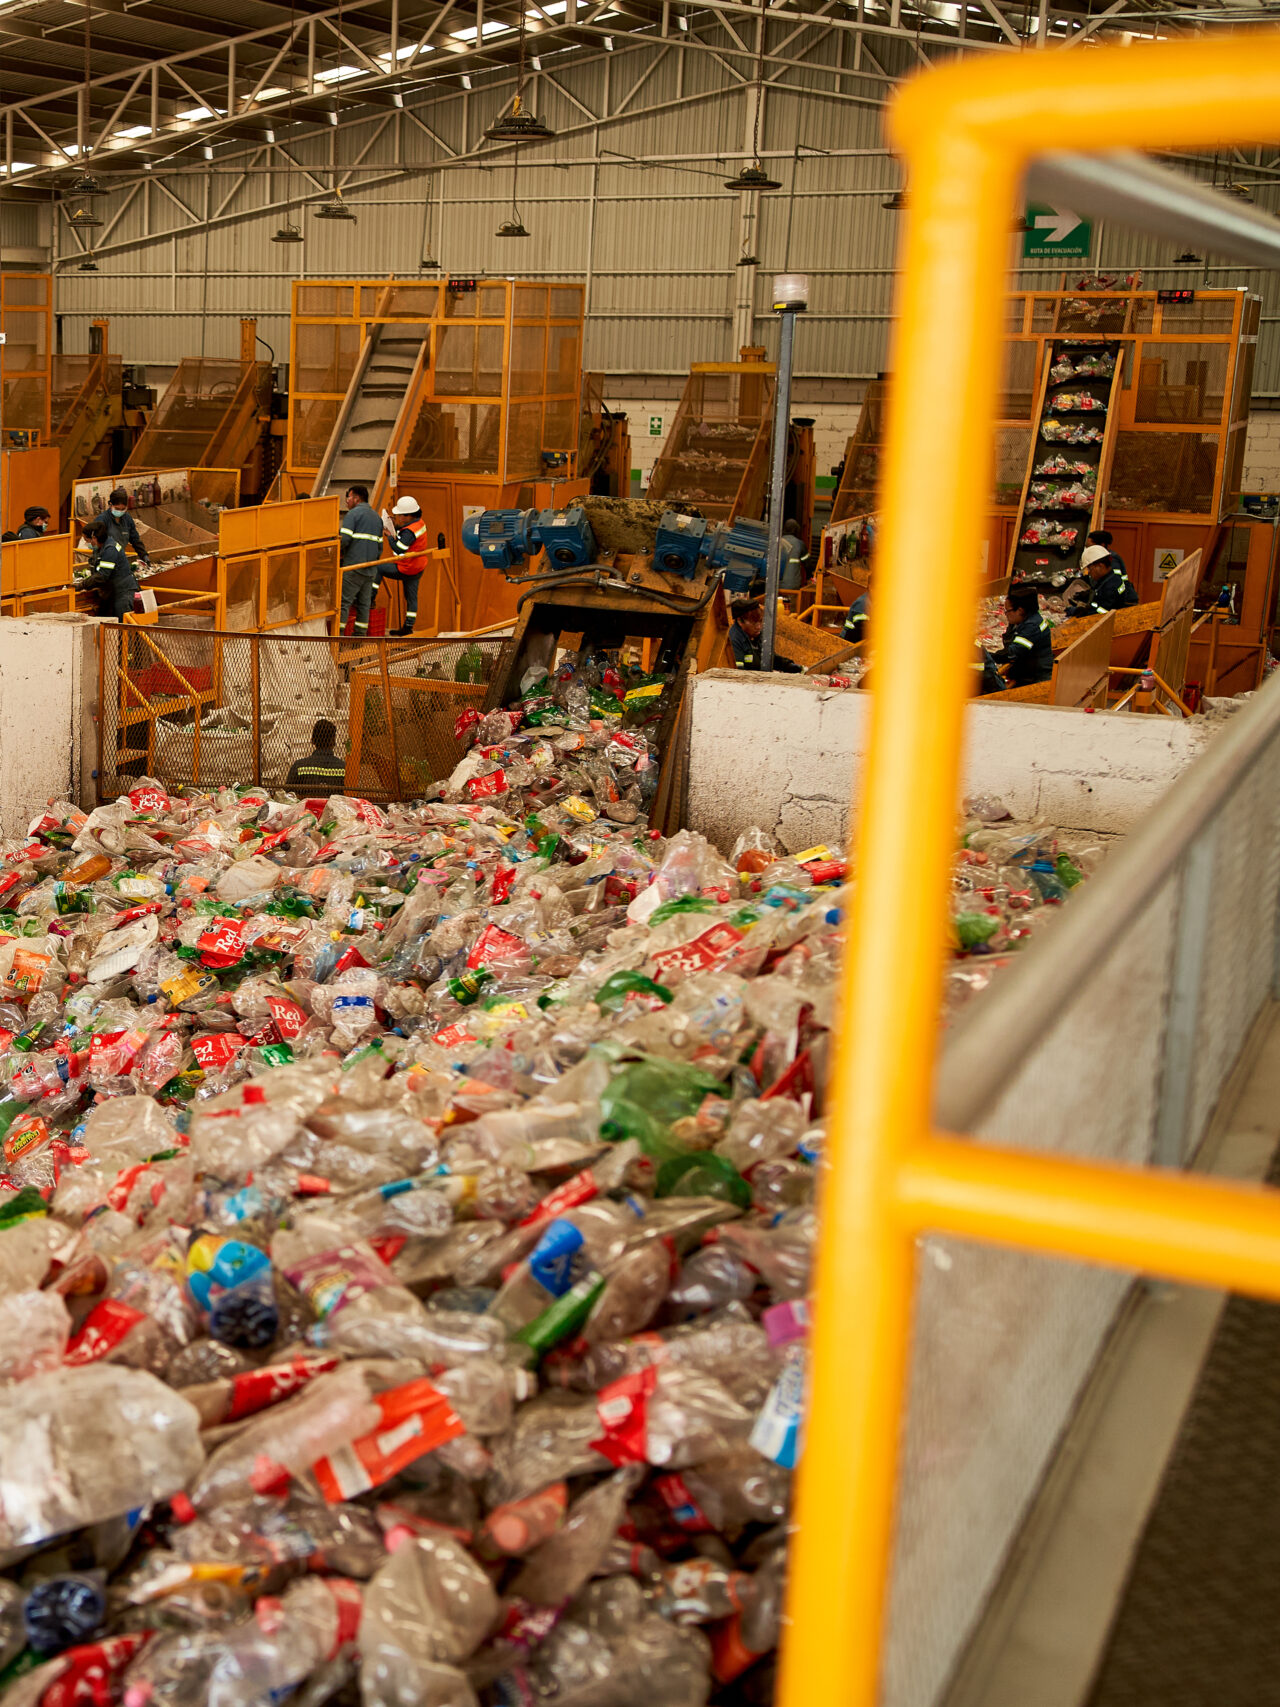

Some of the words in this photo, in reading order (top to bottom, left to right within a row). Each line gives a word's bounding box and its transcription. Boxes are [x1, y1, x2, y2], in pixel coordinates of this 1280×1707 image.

[1051, 246, 1082, 254] EVACUACIÓN
[215, 928, 238, 952] Red
[272, 1004, 301, 1022] Red
[193, 1041, 215, 1055] ed
[197, 1054, 216, 1064] ola
